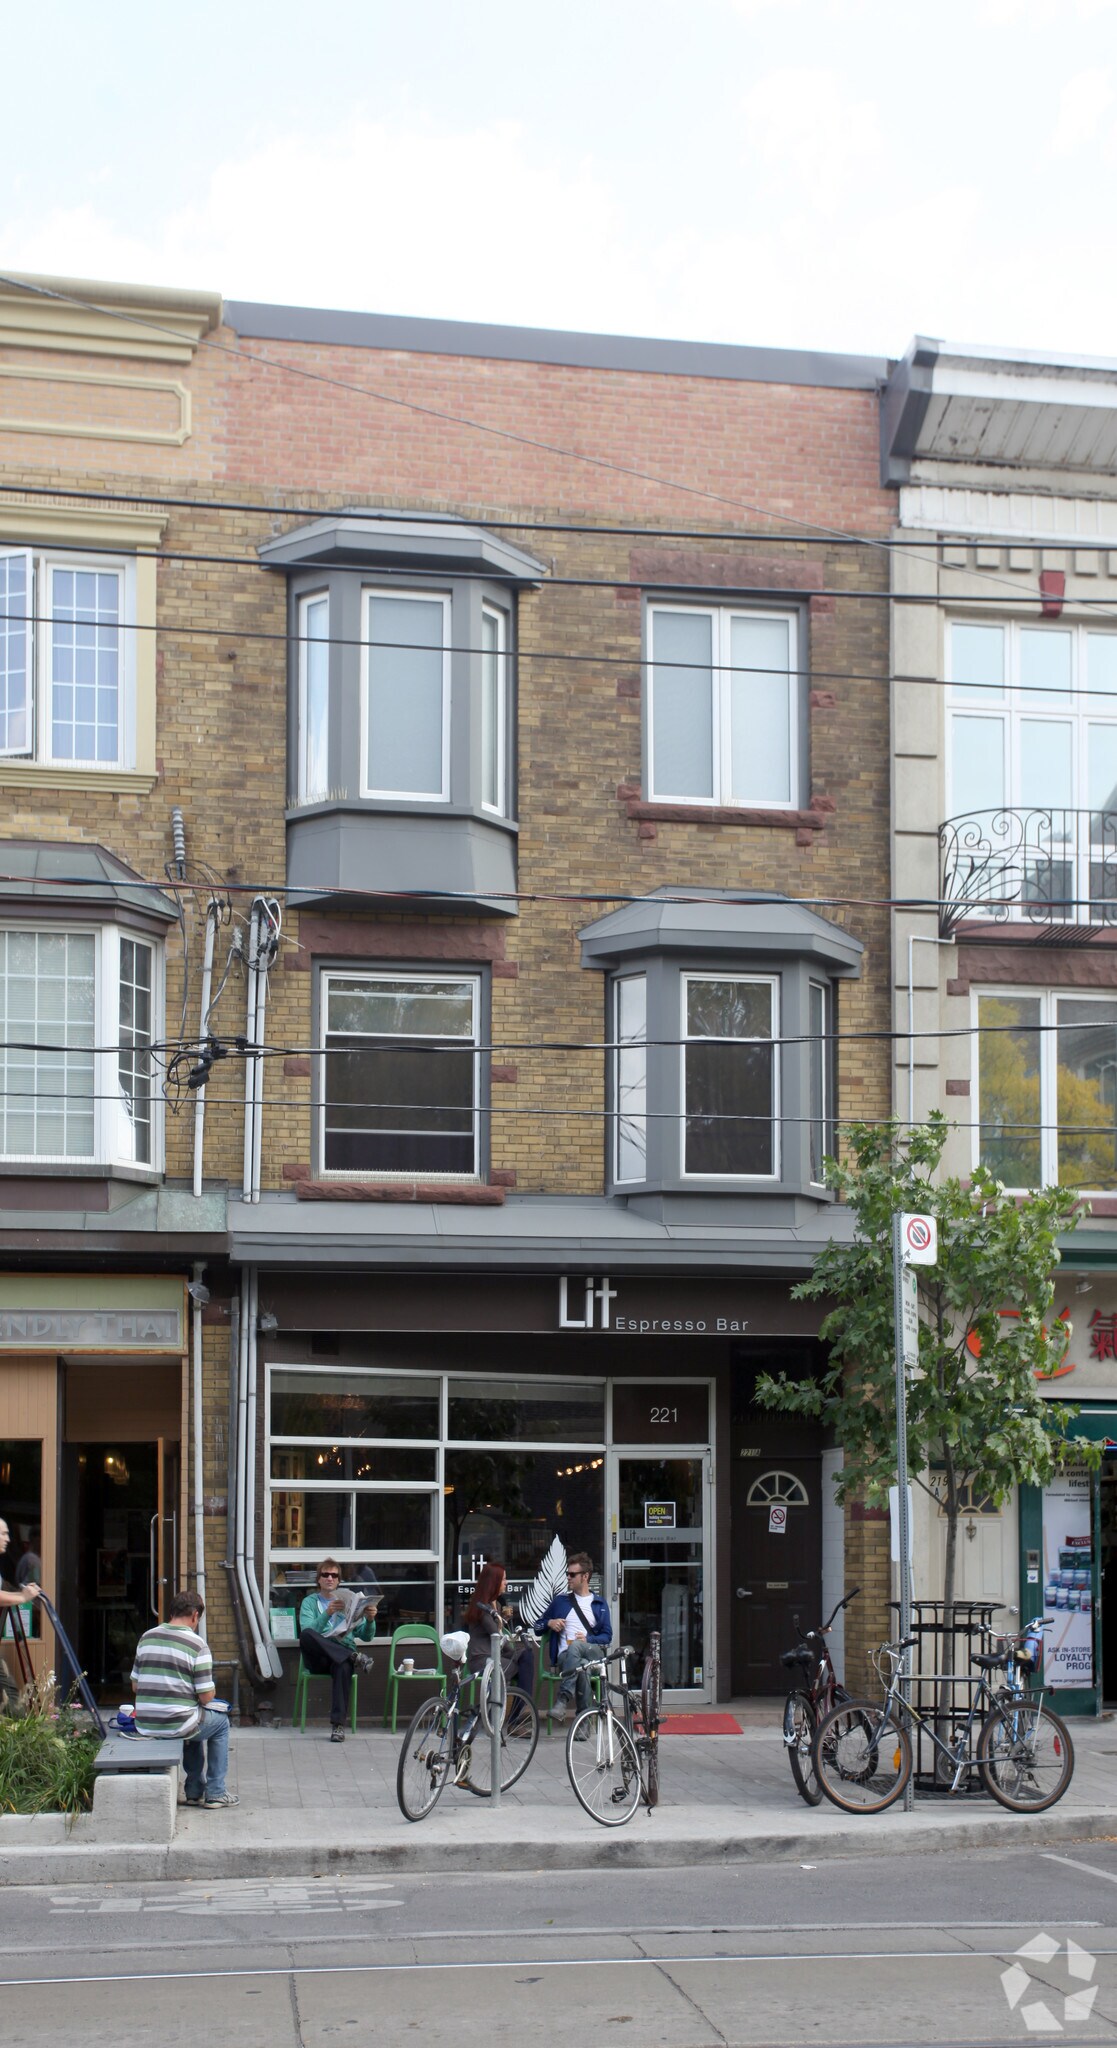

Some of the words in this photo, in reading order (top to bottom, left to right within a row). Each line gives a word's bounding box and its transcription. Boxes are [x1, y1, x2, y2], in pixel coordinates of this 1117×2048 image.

[559, 1276, 617, 1329] Lit
[615, 1317, 706, 1333] Espresso
[716, 1318, 749, 1331] Bar
[0, 1314, 87, 1338] NDLY
[650, 1407, 678, 1423] 221
[648, 1507, 666, 1515] OPEN
[458, 1554, 487, 1582] Lit
[458, 1586, 476, 1595] Esp
[507, 1585, 523, 1593] Bar
[1054, 1653, 1093, 1662] LOYALTY
